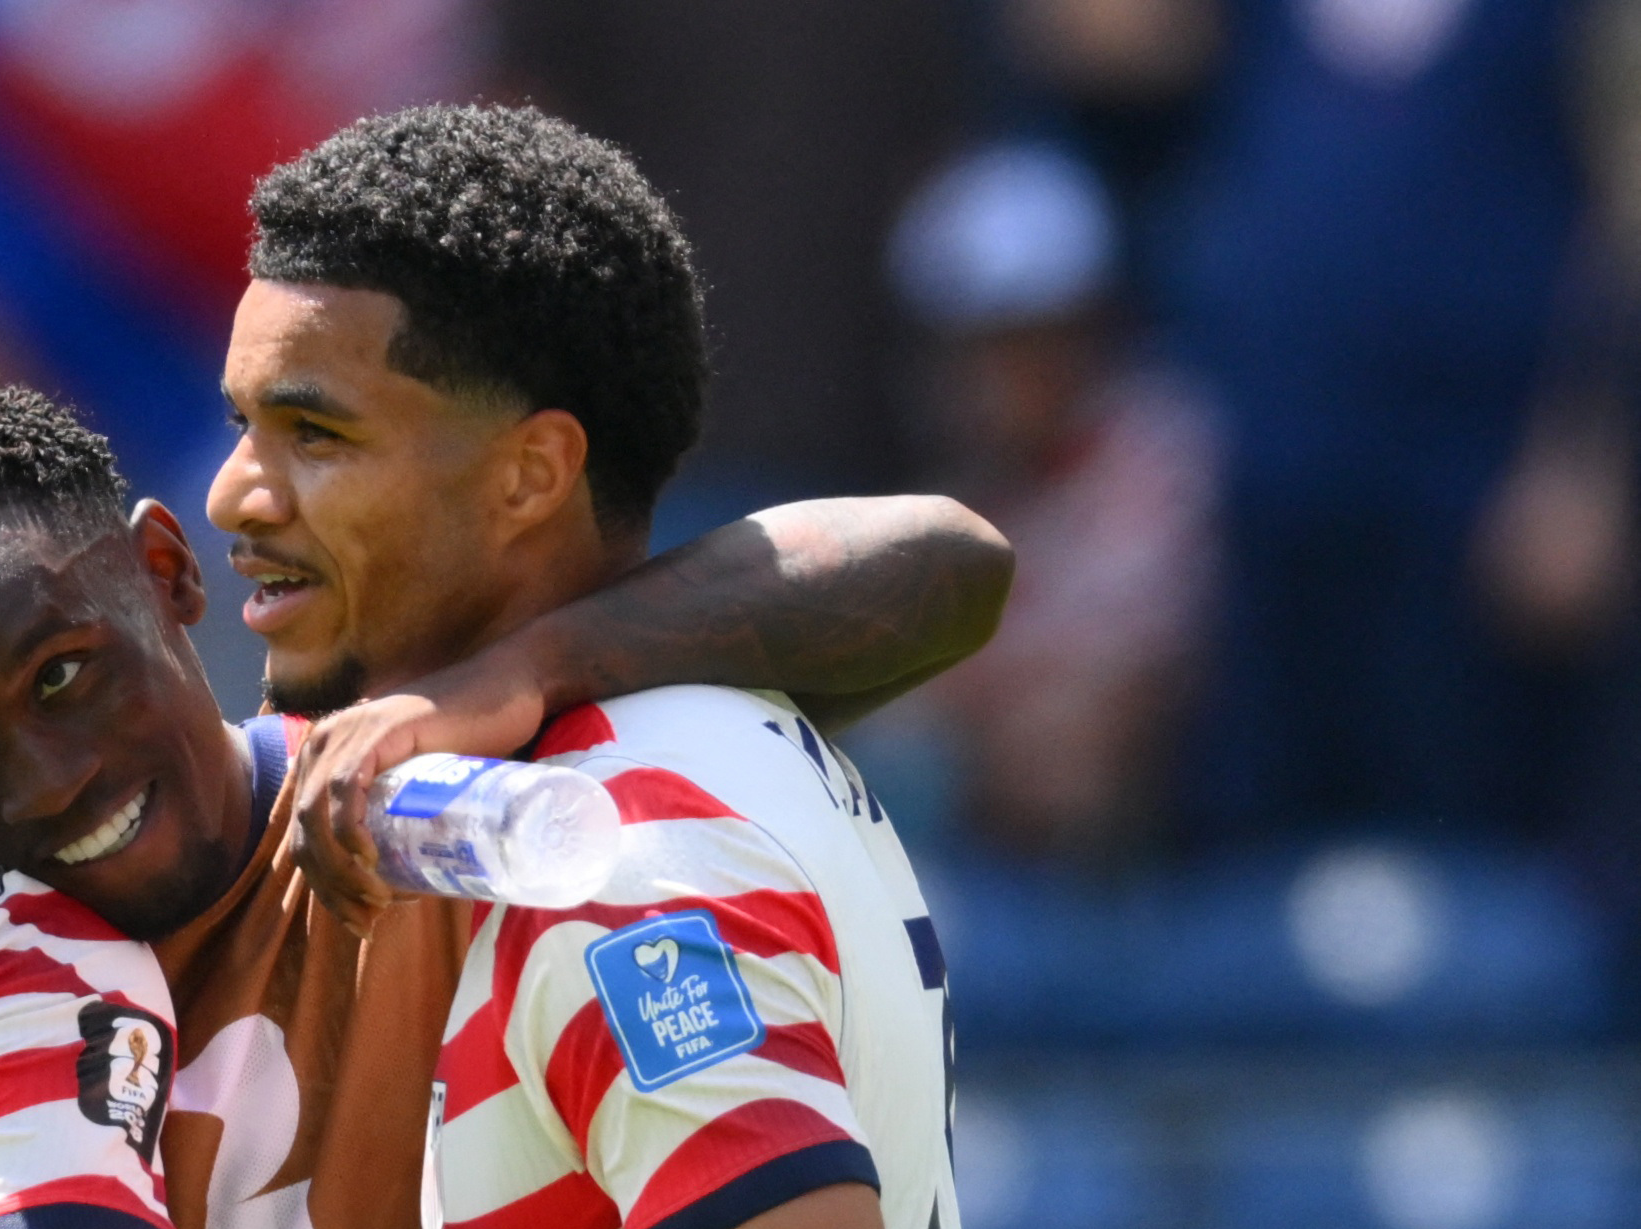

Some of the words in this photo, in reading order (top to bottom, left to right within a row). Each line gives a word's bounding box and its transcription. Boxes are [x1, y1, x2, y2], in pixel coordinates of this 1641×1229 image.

[638, 986, 685, 1022] Unite
[680, 974, 709, 1004] For
[652, 1000, 720, 1048] PEACE
[675, 1035, 711, 1059] FIFA
[121, 1085, 147, 1101] FIFA
